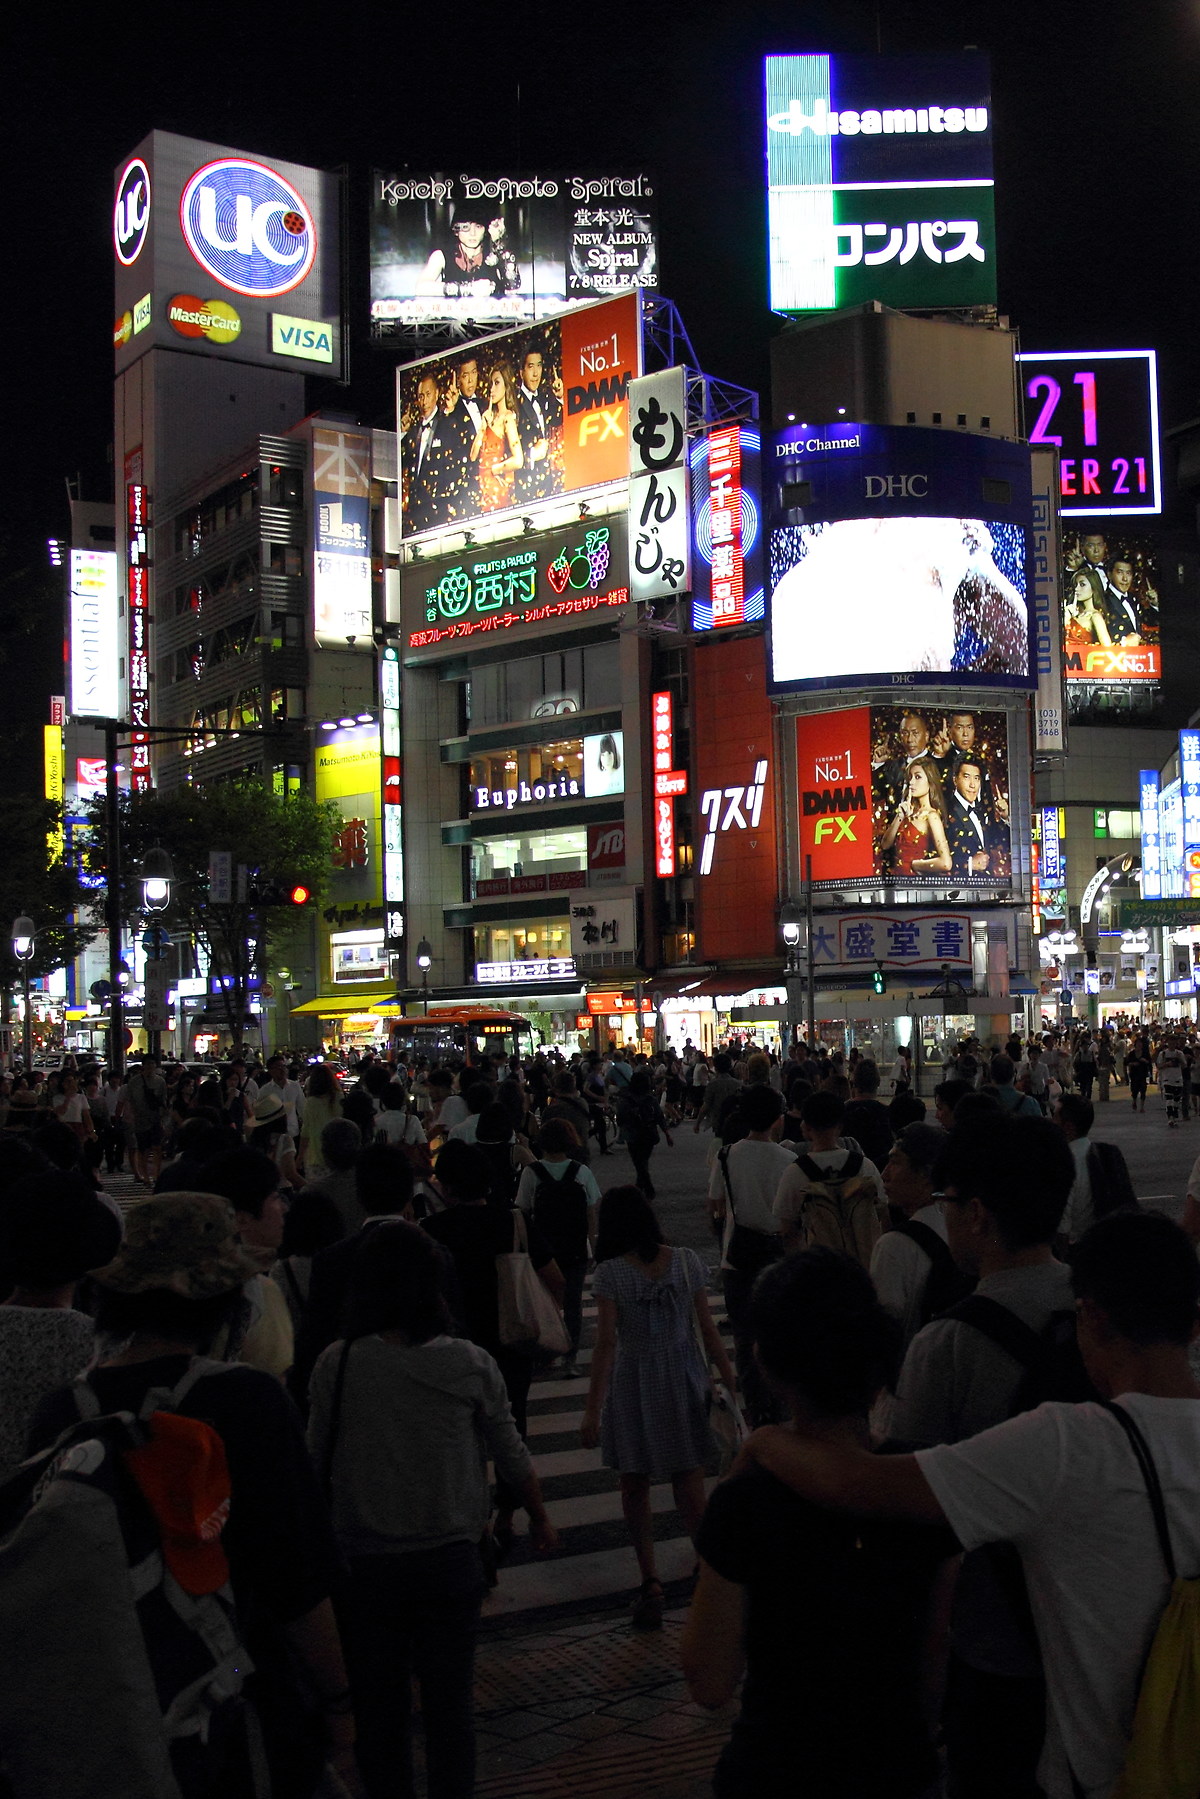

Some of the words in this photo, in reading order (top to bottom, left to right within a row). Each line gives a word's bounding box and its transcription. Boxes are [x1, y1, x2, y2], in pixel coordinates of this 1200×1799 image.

[380, 176, 454, 206] Koichi
[459, 174, 559, 205] Domoto
[573, 207, 652, 227] 堂本光一
[573, 233, 602, 246] NEW
[606, 233, 653, 245] ALBUM
[833, 220, 985, 267] ロンパス
[586, 248, 640, 268] Spiral
[593, 274, 658, 288] RELEASE
[170, 306, 240, 332] MasterCard
[279, 326, 331, 352] VISA
[580, 333, 621, 377] No.1
[567, 370, 633, 417] DMM
[1028, 371, 1098, 447] 21
[578, 405, 626, 447] FX
[776, 441, 804, 457] DHC
[806, 434, 860, 453] Channel
[314, 433, 370, 495] 本
[1111, 457, 1147, 494] 21
[632, 396, 686, 589] もんじゃ
[865, 475, 928, 498] DHC
[709, 436, 736, 616] 三千里薬品
[474, 566, 537, 612] 西村
[426, 588, 438, 623] 渋谷
[891, 673, 915, 684] DHC
[1038, 719, 1059, 728] 3719
[1039, 709, 1058, 719] (03)
[1038, 728, 1060, 737] 2468
[815, 749, 854, 783] No.1
[477, 776, 580, 810] Euphoria
[802, 785, 868, 817] DMM
[814, 814, 858, 845] FX
